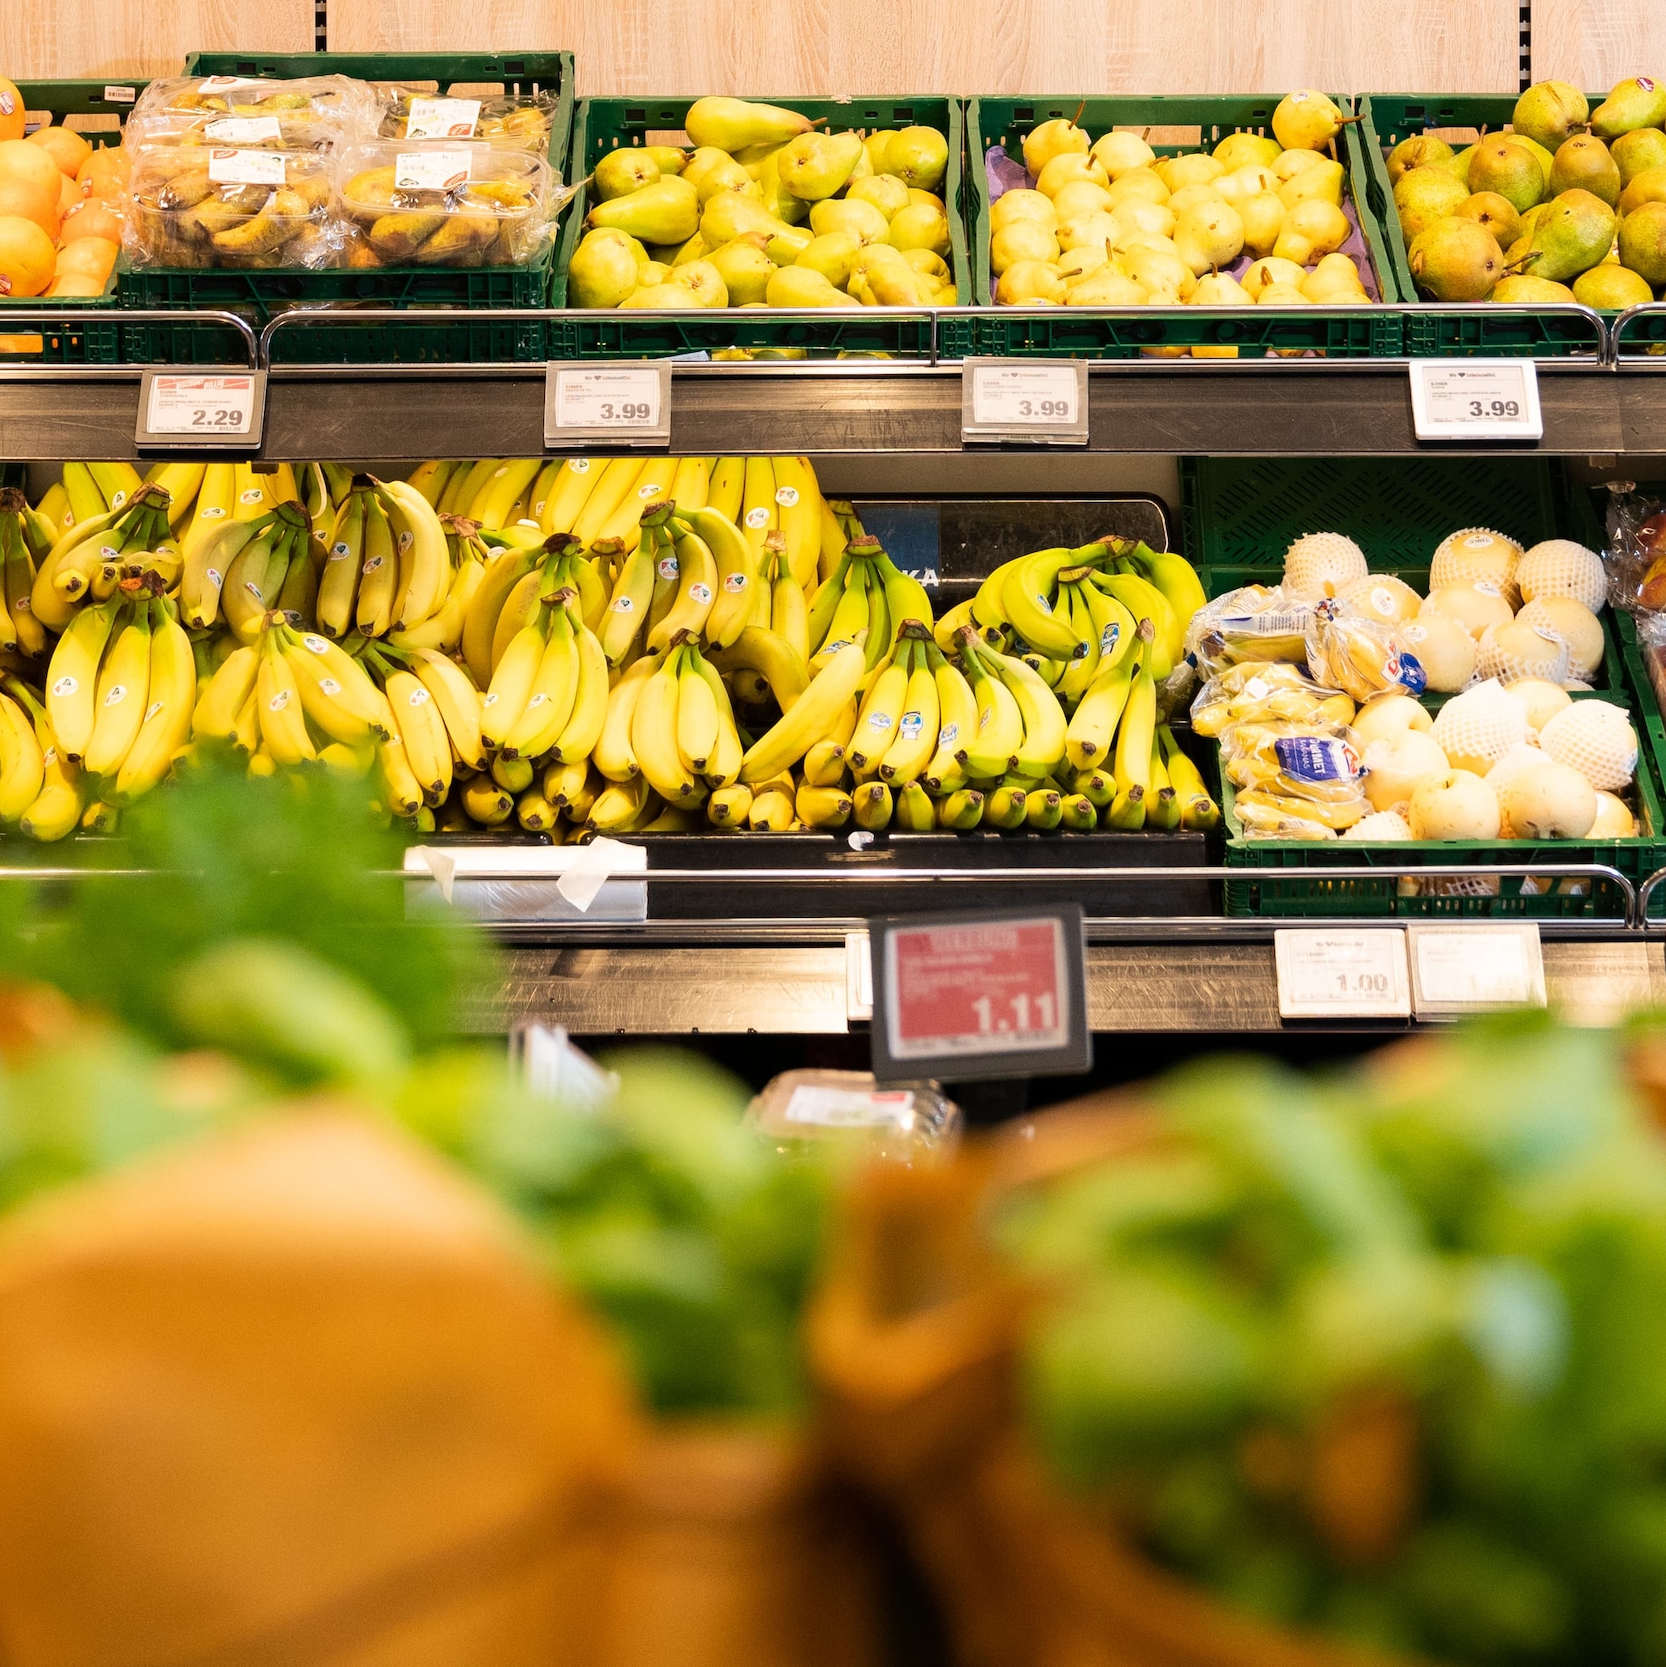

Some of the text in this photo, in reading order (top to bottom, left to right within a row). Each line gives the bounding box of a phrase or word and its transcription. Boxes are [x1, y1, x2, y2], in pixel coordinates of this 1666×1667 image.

[600, 403, 651, 419] 3.99
[1018, 400, 1069, 416] 3.99
[1469, 400, 1519, 416] 3.99
[192, 409, 243, 426] 2.29
[1336, 973, 1388, 992] 1.00
[971, 991, 1055, 1036] 1.11
